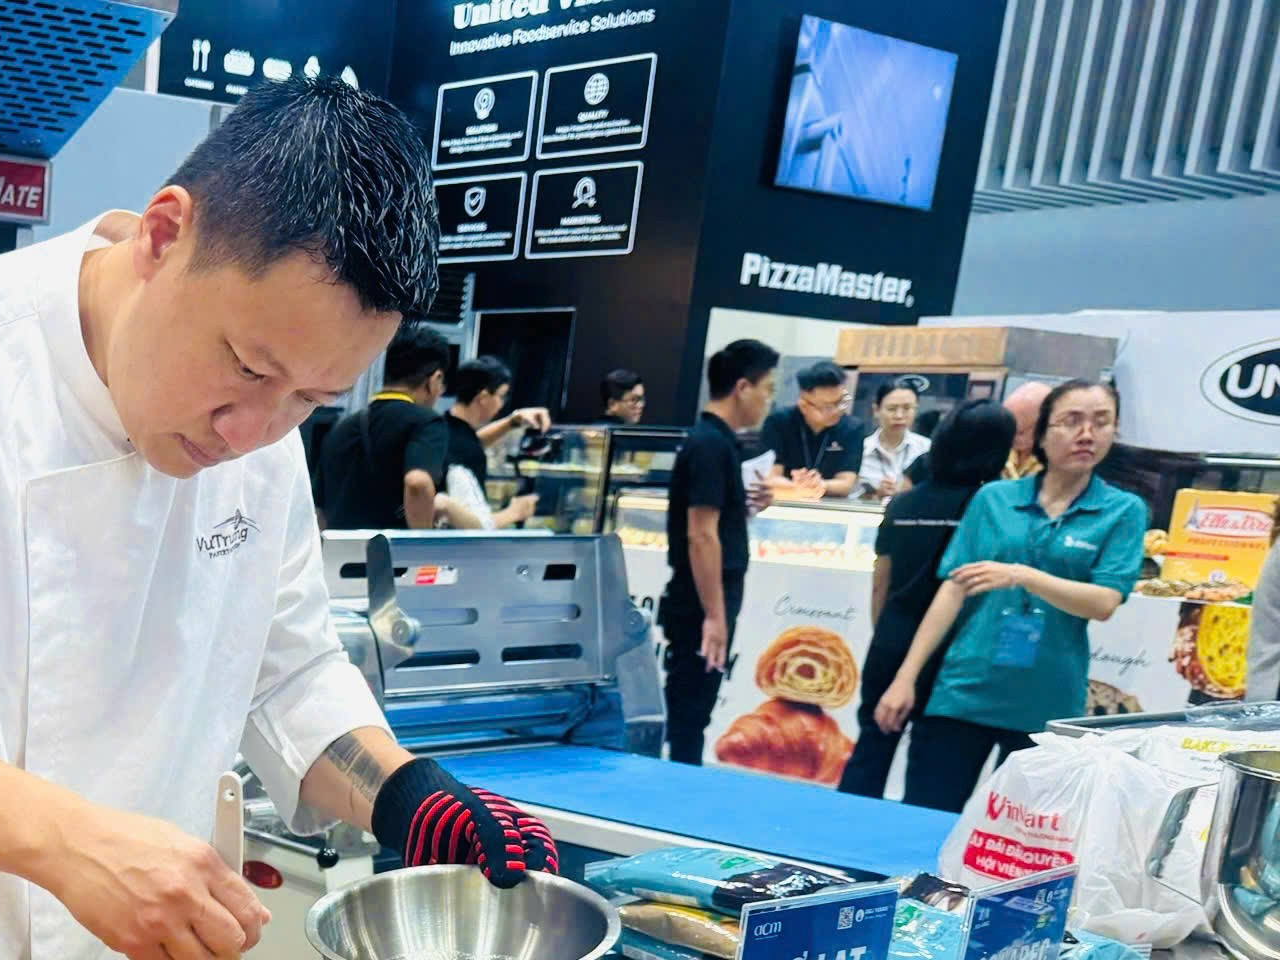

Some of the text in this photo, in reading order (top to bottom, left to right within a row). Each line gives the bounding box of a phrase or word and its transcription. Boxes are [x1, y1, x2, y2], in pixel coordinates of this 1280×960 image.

[449, 8, 656, 56] Innovative Foodservice Solutions
[754, 921, 782, 937] acm
